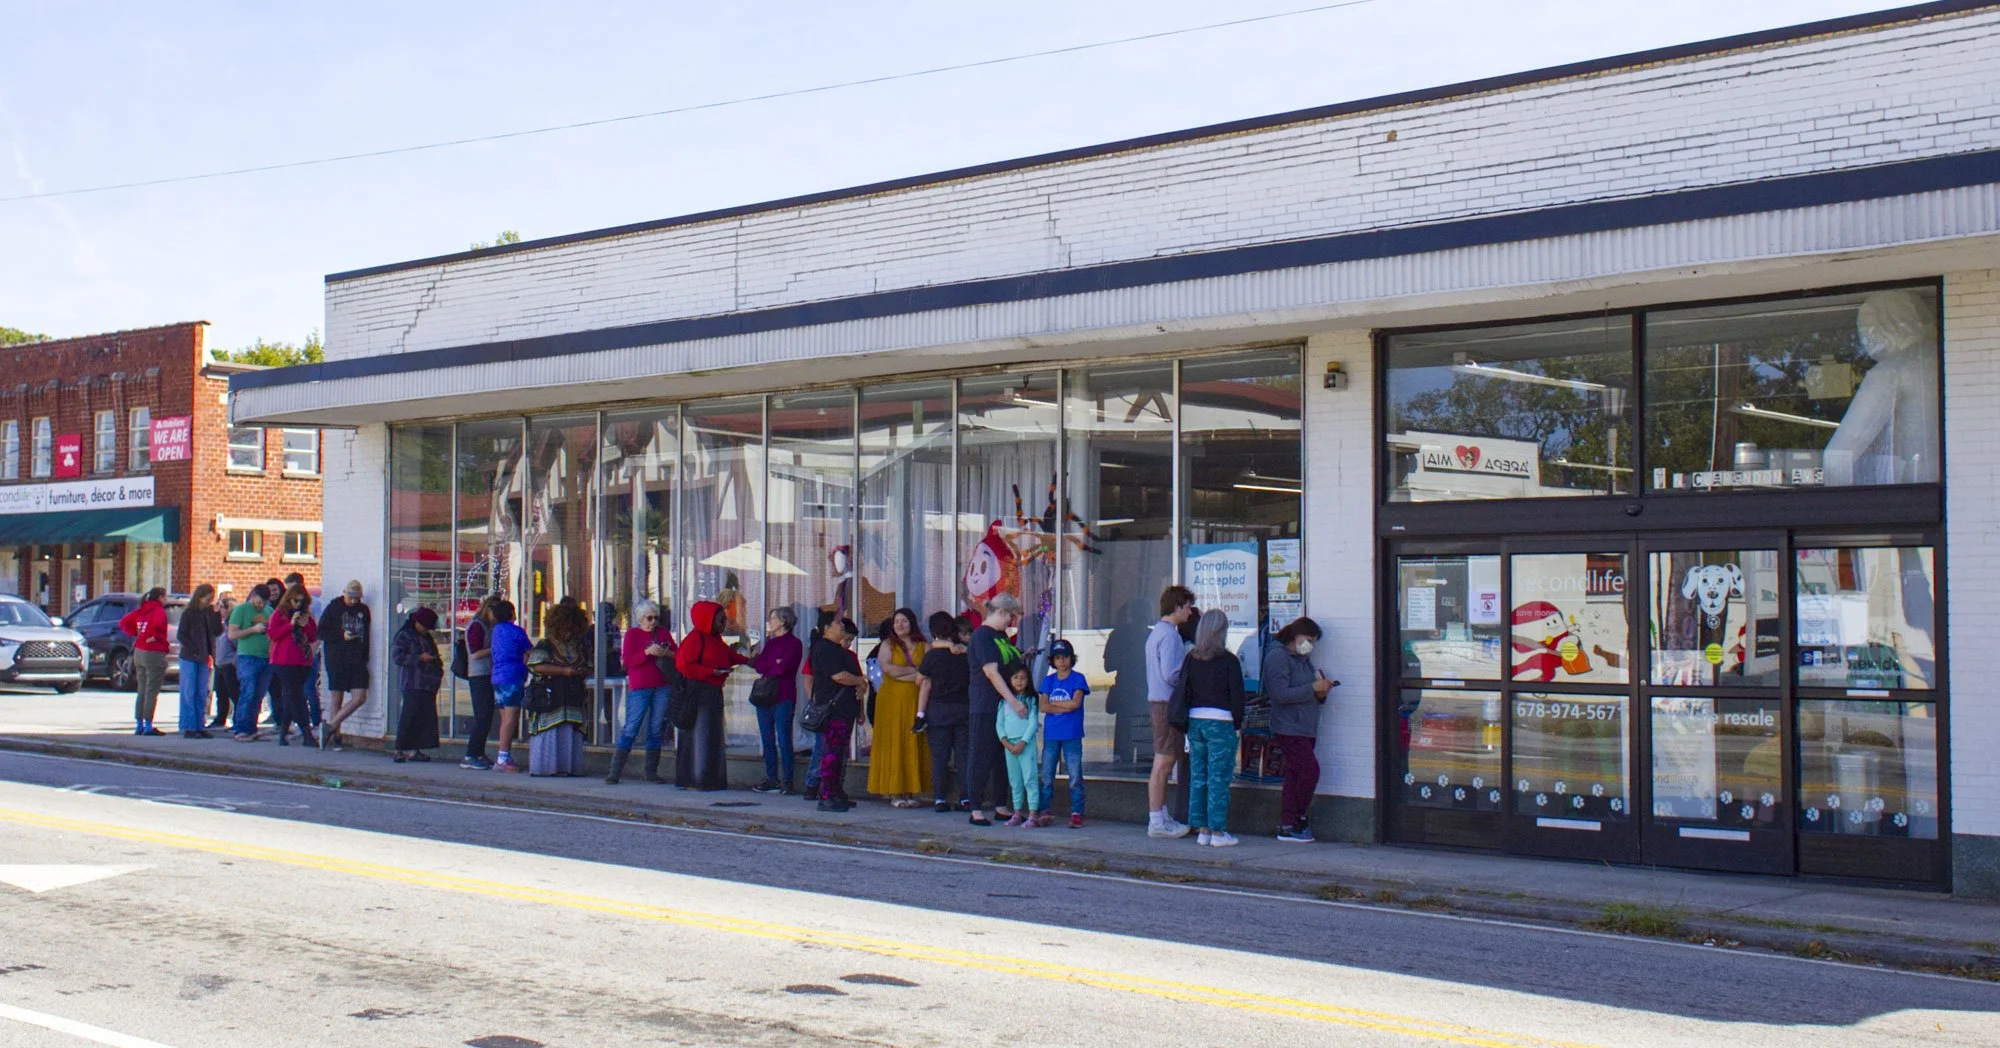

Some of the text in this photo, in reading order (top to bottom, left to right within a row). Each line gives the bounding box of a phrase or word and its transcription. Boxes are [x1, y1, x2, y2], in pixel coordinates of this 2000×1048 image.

[154, 428, 189, 445] WE ARE
[157, 445, 184, 461] OPEN
[49, 490, 89, 506] furniture,
[119, 486, 126, 500] &
[129, 488, 152, 500] more
[1194, 560, 1247, 572] Donations
[1193, 575, 1246, 588] Accepted
[1724, 708, 1774, 726] resale
